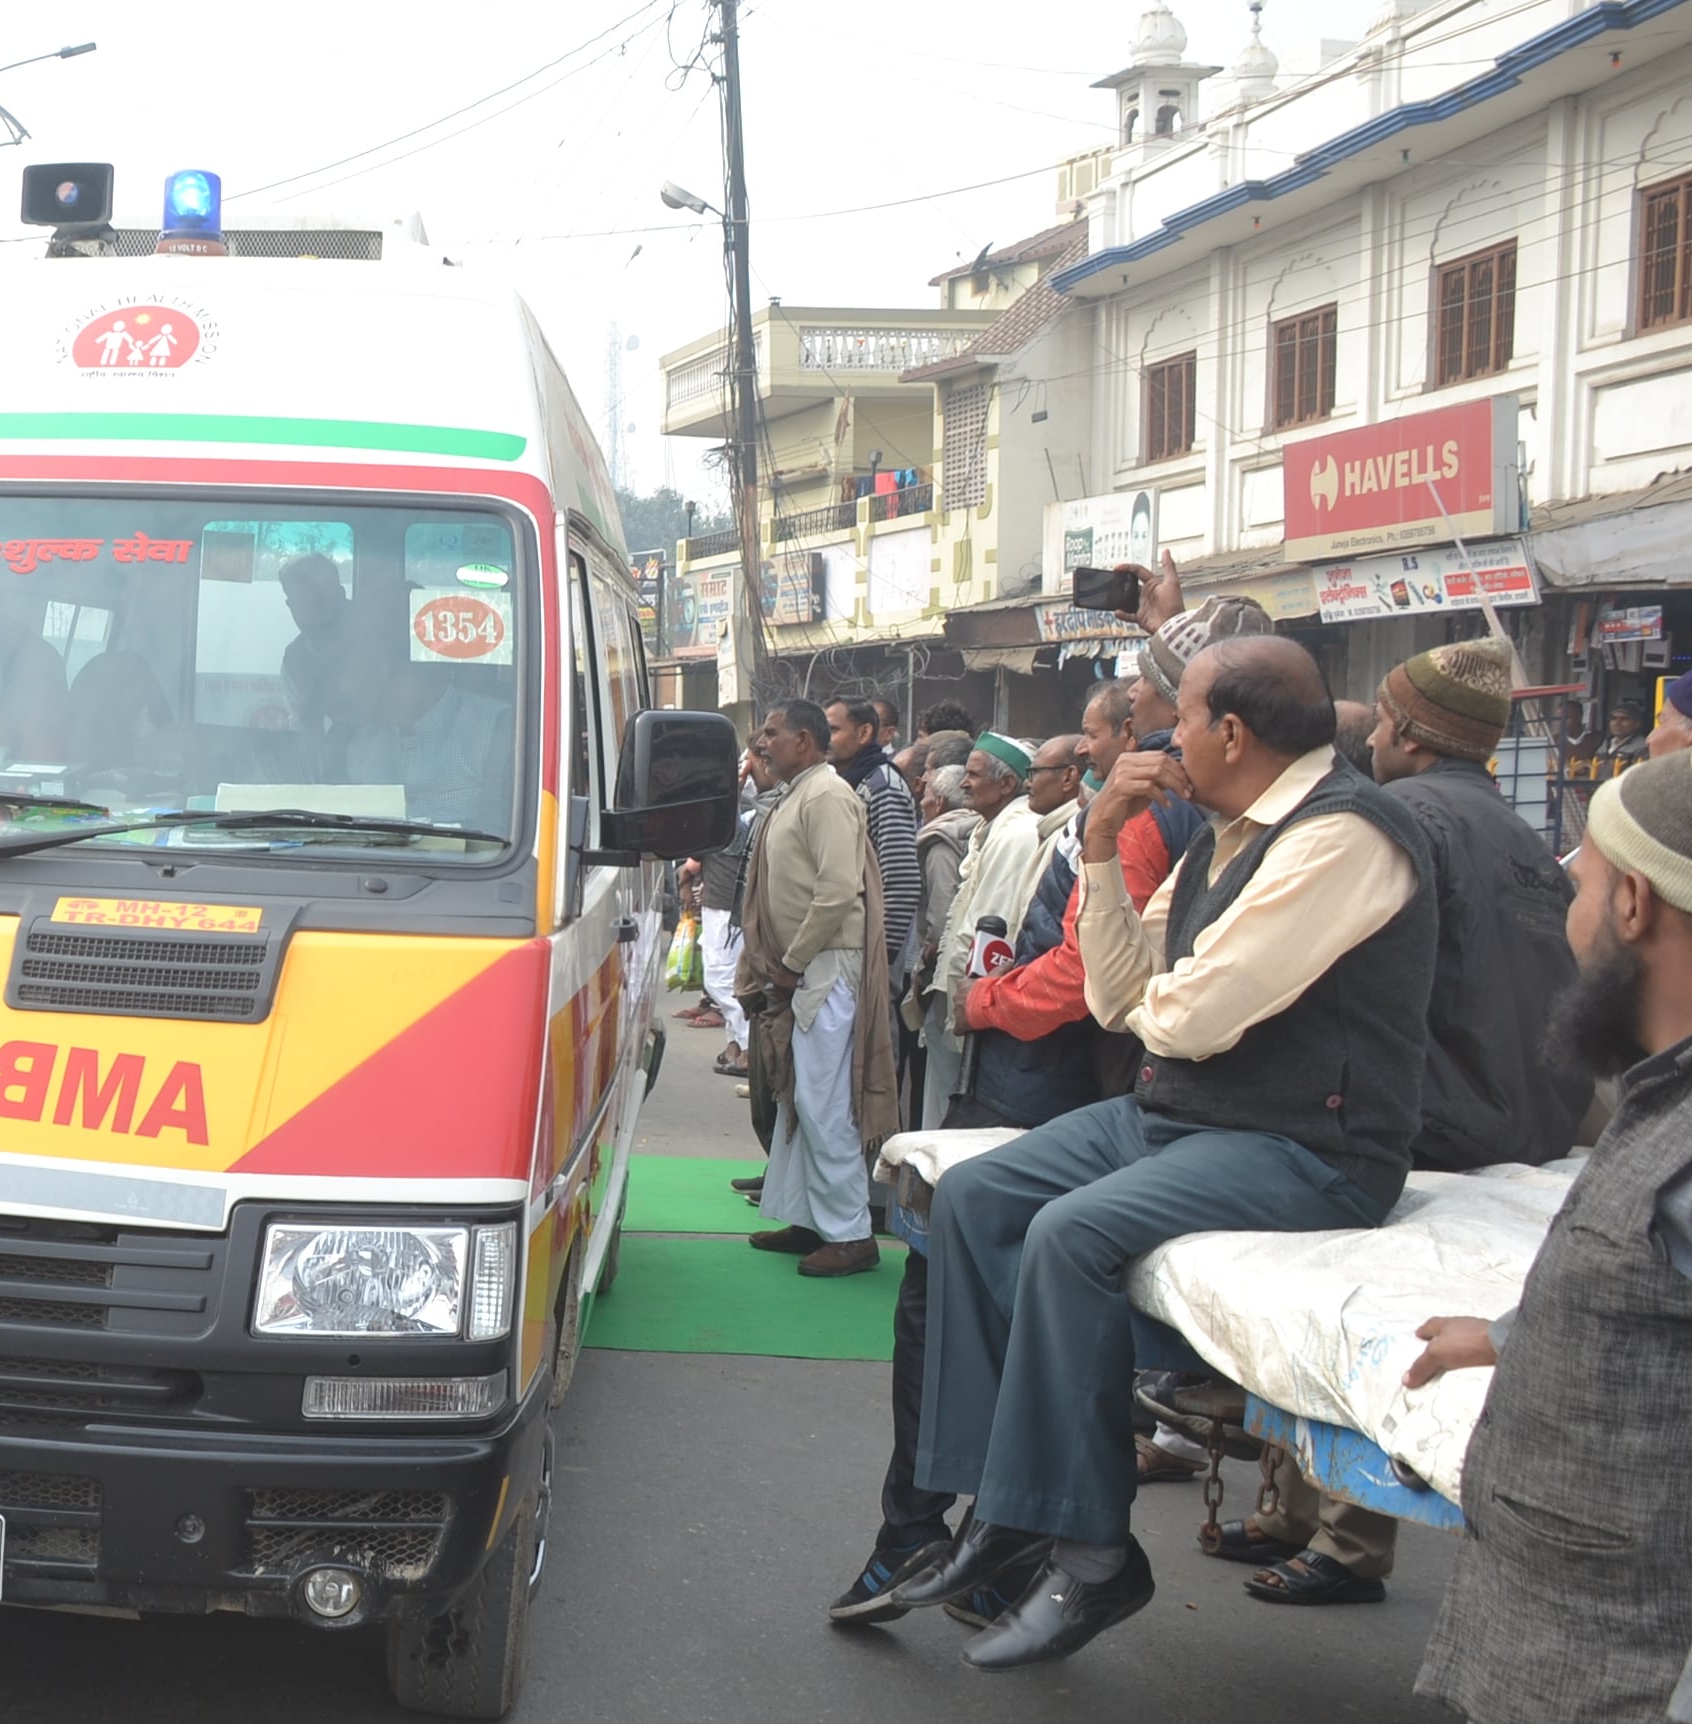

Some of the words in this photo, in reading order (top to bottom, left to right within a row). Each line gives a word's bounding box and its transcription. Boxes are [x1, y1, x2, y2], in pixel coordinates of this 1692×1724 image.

[177, 244, 195, 252] VOLT
[1344, 440, 1459, 496] HAVELLS
[113, 531, 194, 563] सेवा
[1331, 540, 1349, 550] Juneja
[422, 609, 498, 644] 1354
[116, 901, 207, 917] MH-12
[64, 911, 190, 928] TR-DHY
[198, 919, 255, 931] 644
